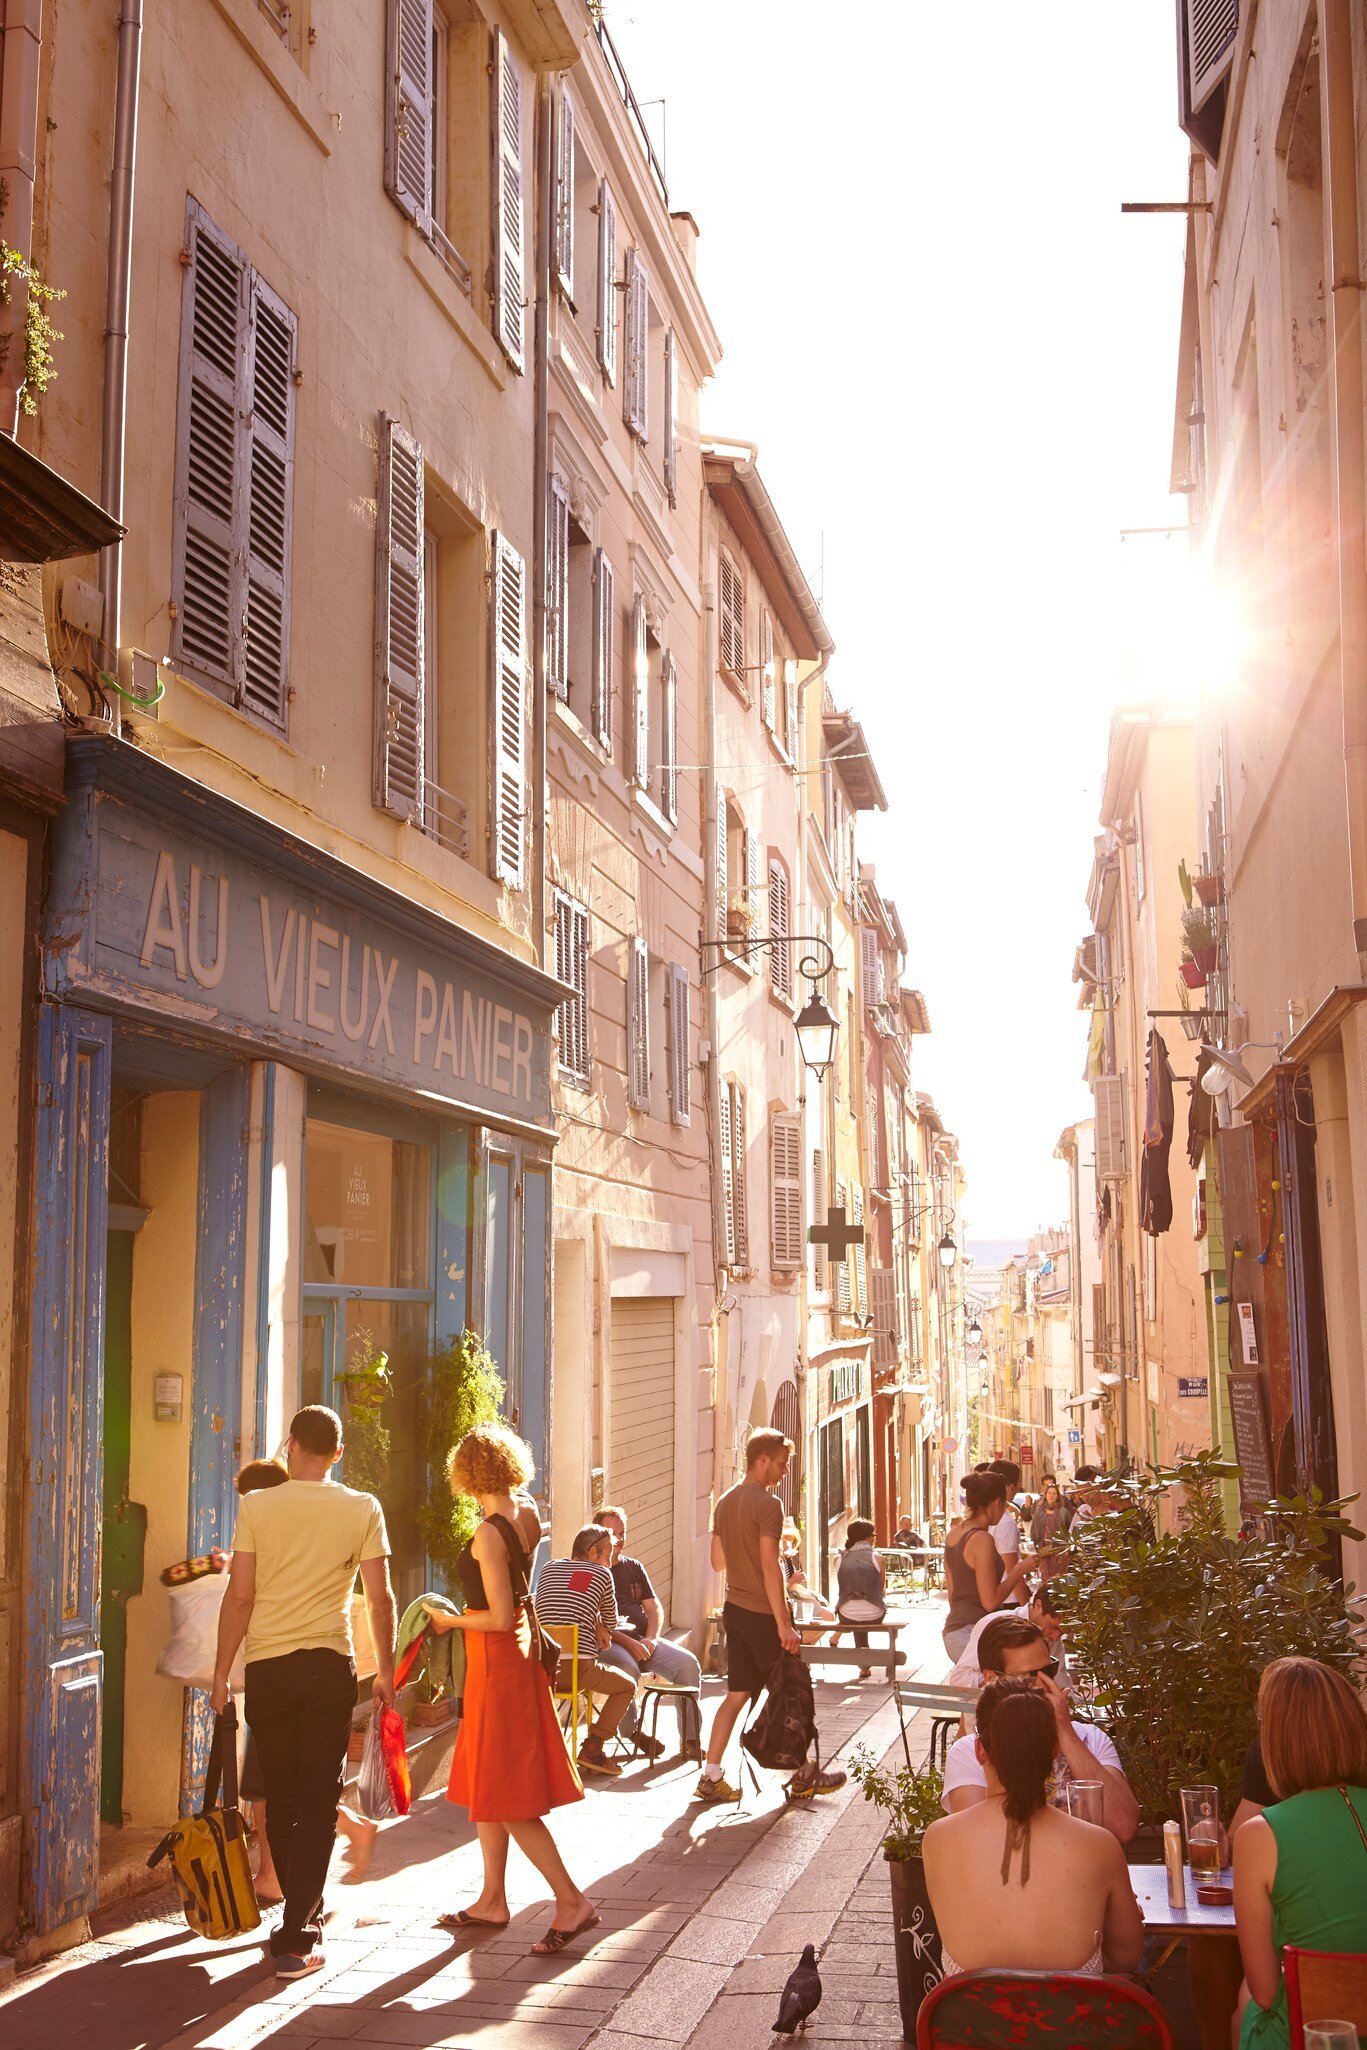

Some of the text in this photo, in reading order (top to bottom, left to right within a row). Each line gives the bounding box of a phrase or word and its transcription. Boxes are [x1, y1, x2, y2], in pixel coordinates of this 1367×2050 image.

[138, 849, 533, 1103] AU VIEUX PANIER
[353, 1164, 363, 1177] AU
[348, 1177, 367, 1191] VIEUX
[346, 1191, 370, 1206] PANIER
